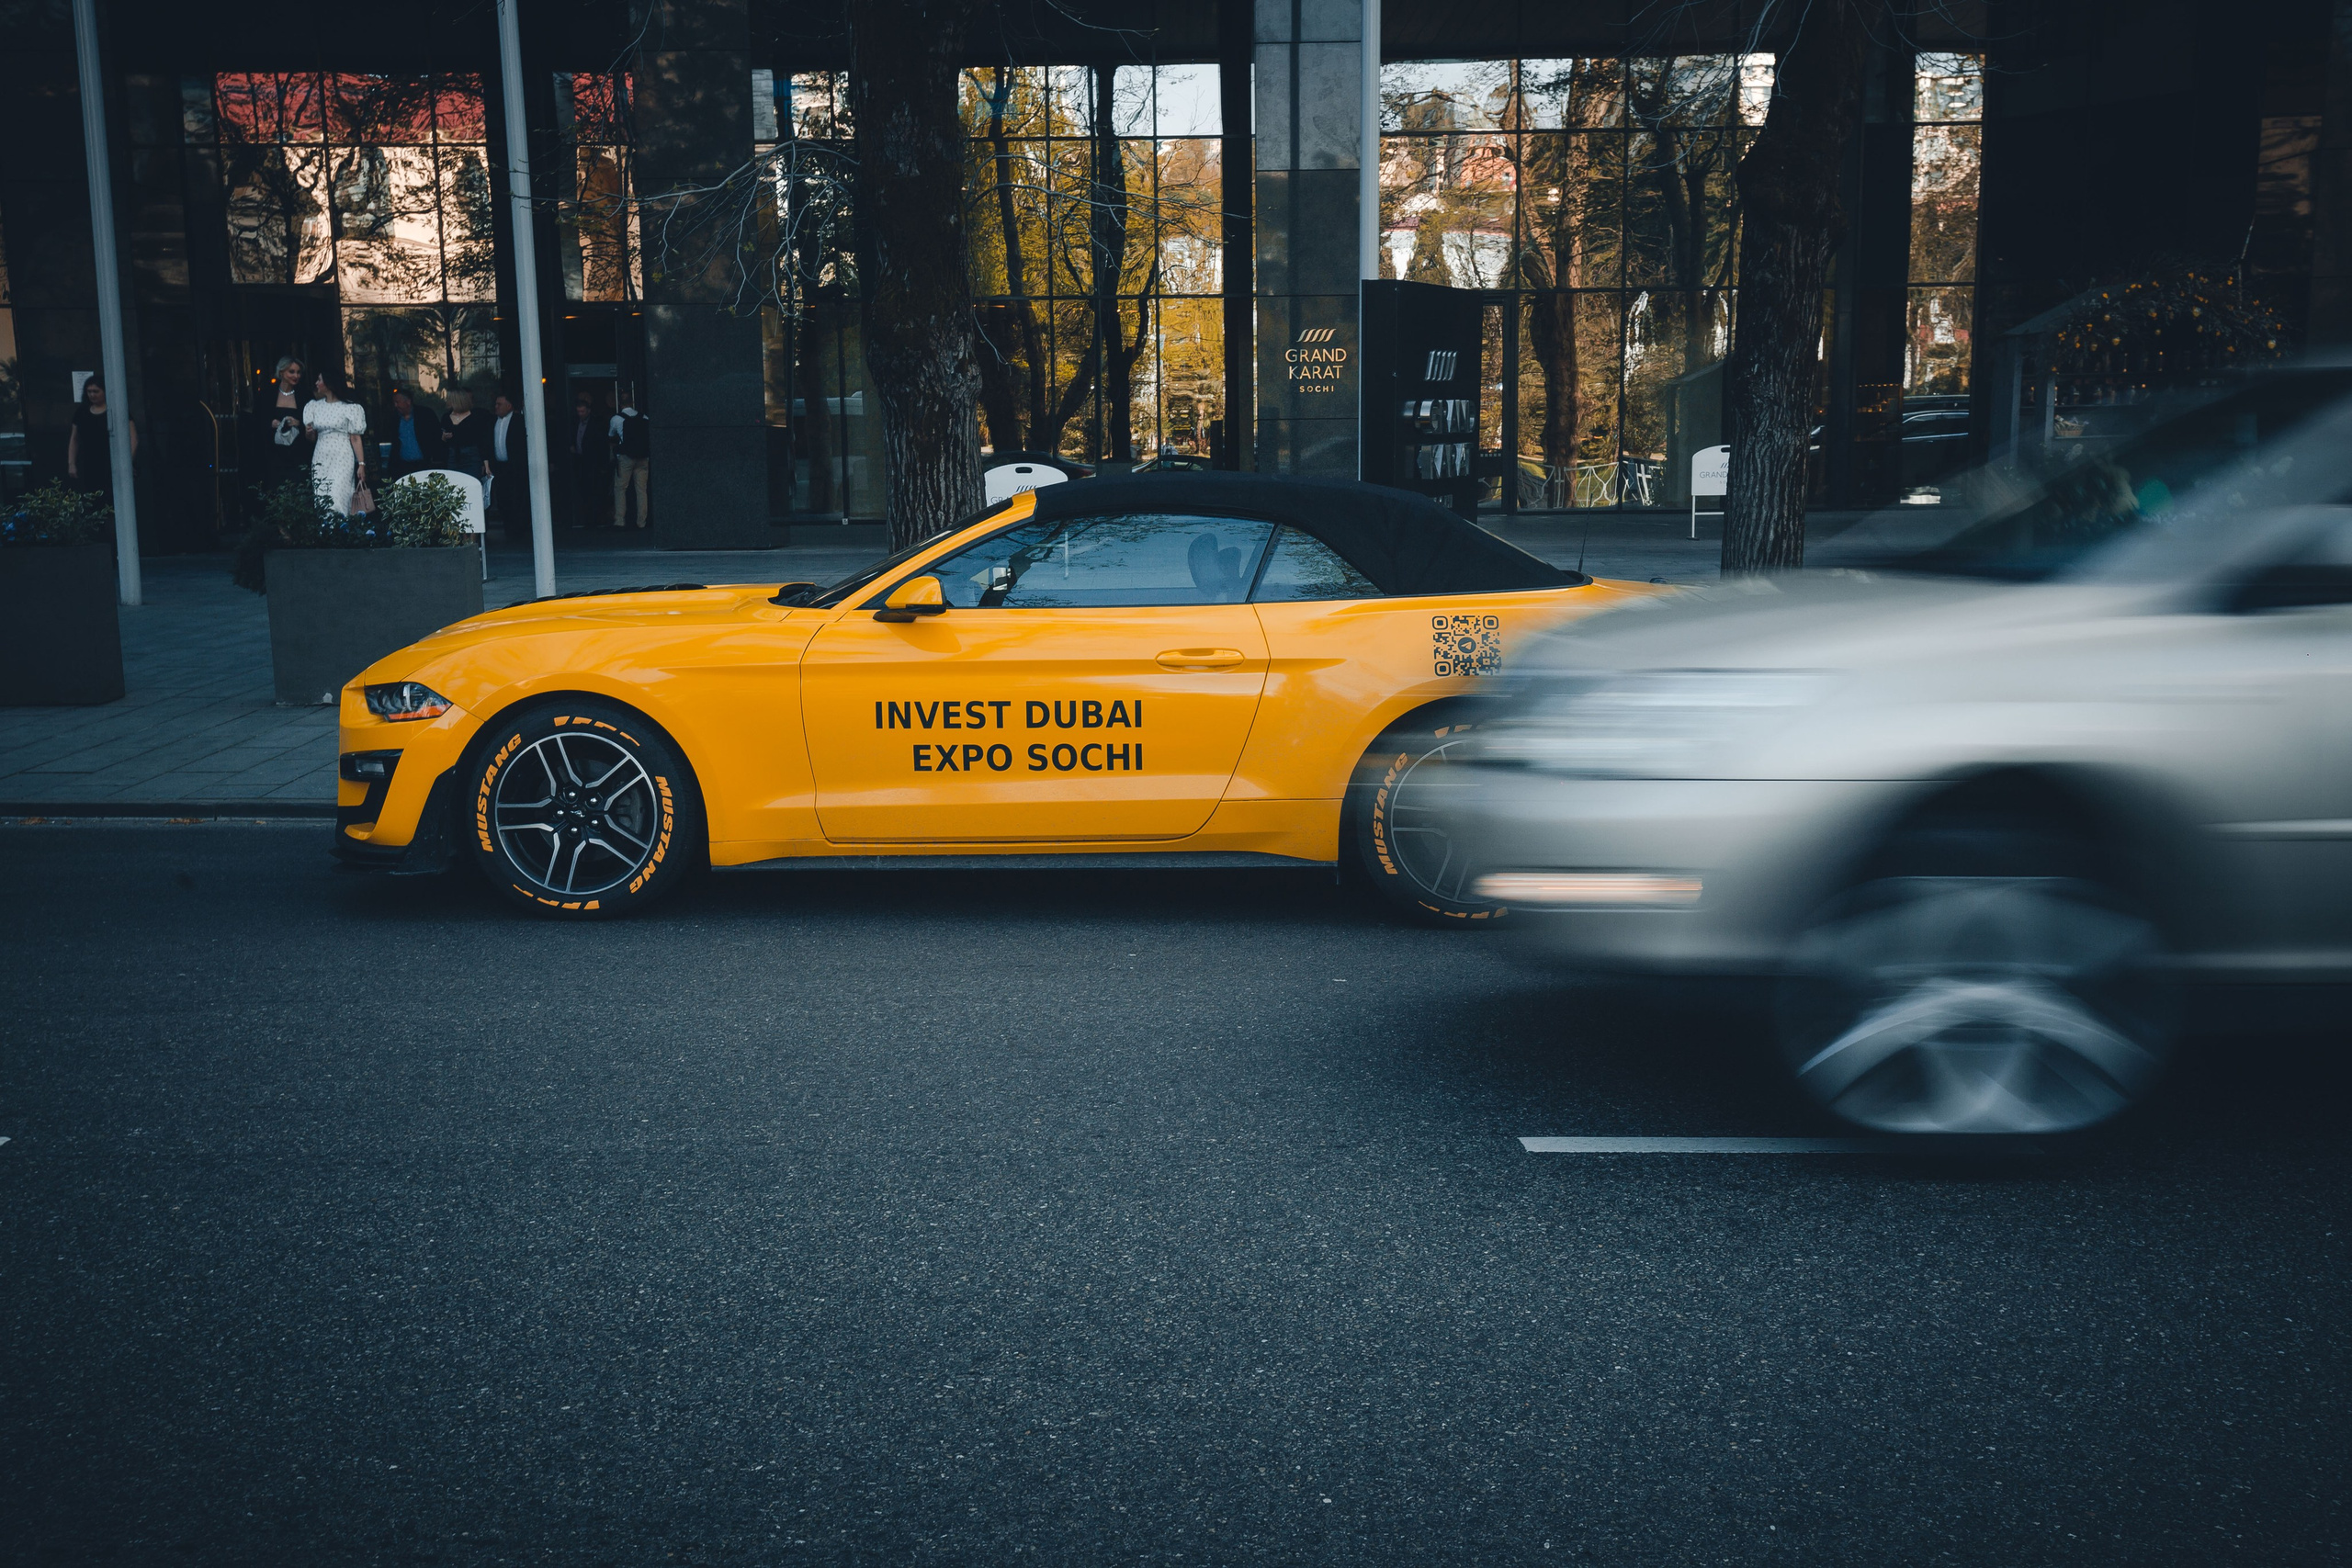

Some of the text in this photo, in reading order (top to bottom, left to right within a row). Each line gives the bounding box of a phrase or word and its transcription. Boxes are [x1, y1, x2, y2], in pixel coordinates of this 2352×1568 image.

[1285, 348, 1347, 363] GRAND
[1288, 365, 1343, 379] KARAT
[876, 700, 1142, 729] INVEST DUBAI
[913, 743, 1143, 772] EXPO SOCHI
[475, 733, 522, 852] MUSTANG
[1373, 751, 1409, 875] MUSTANG
[628, 775, 674, 895] MUSTANG
